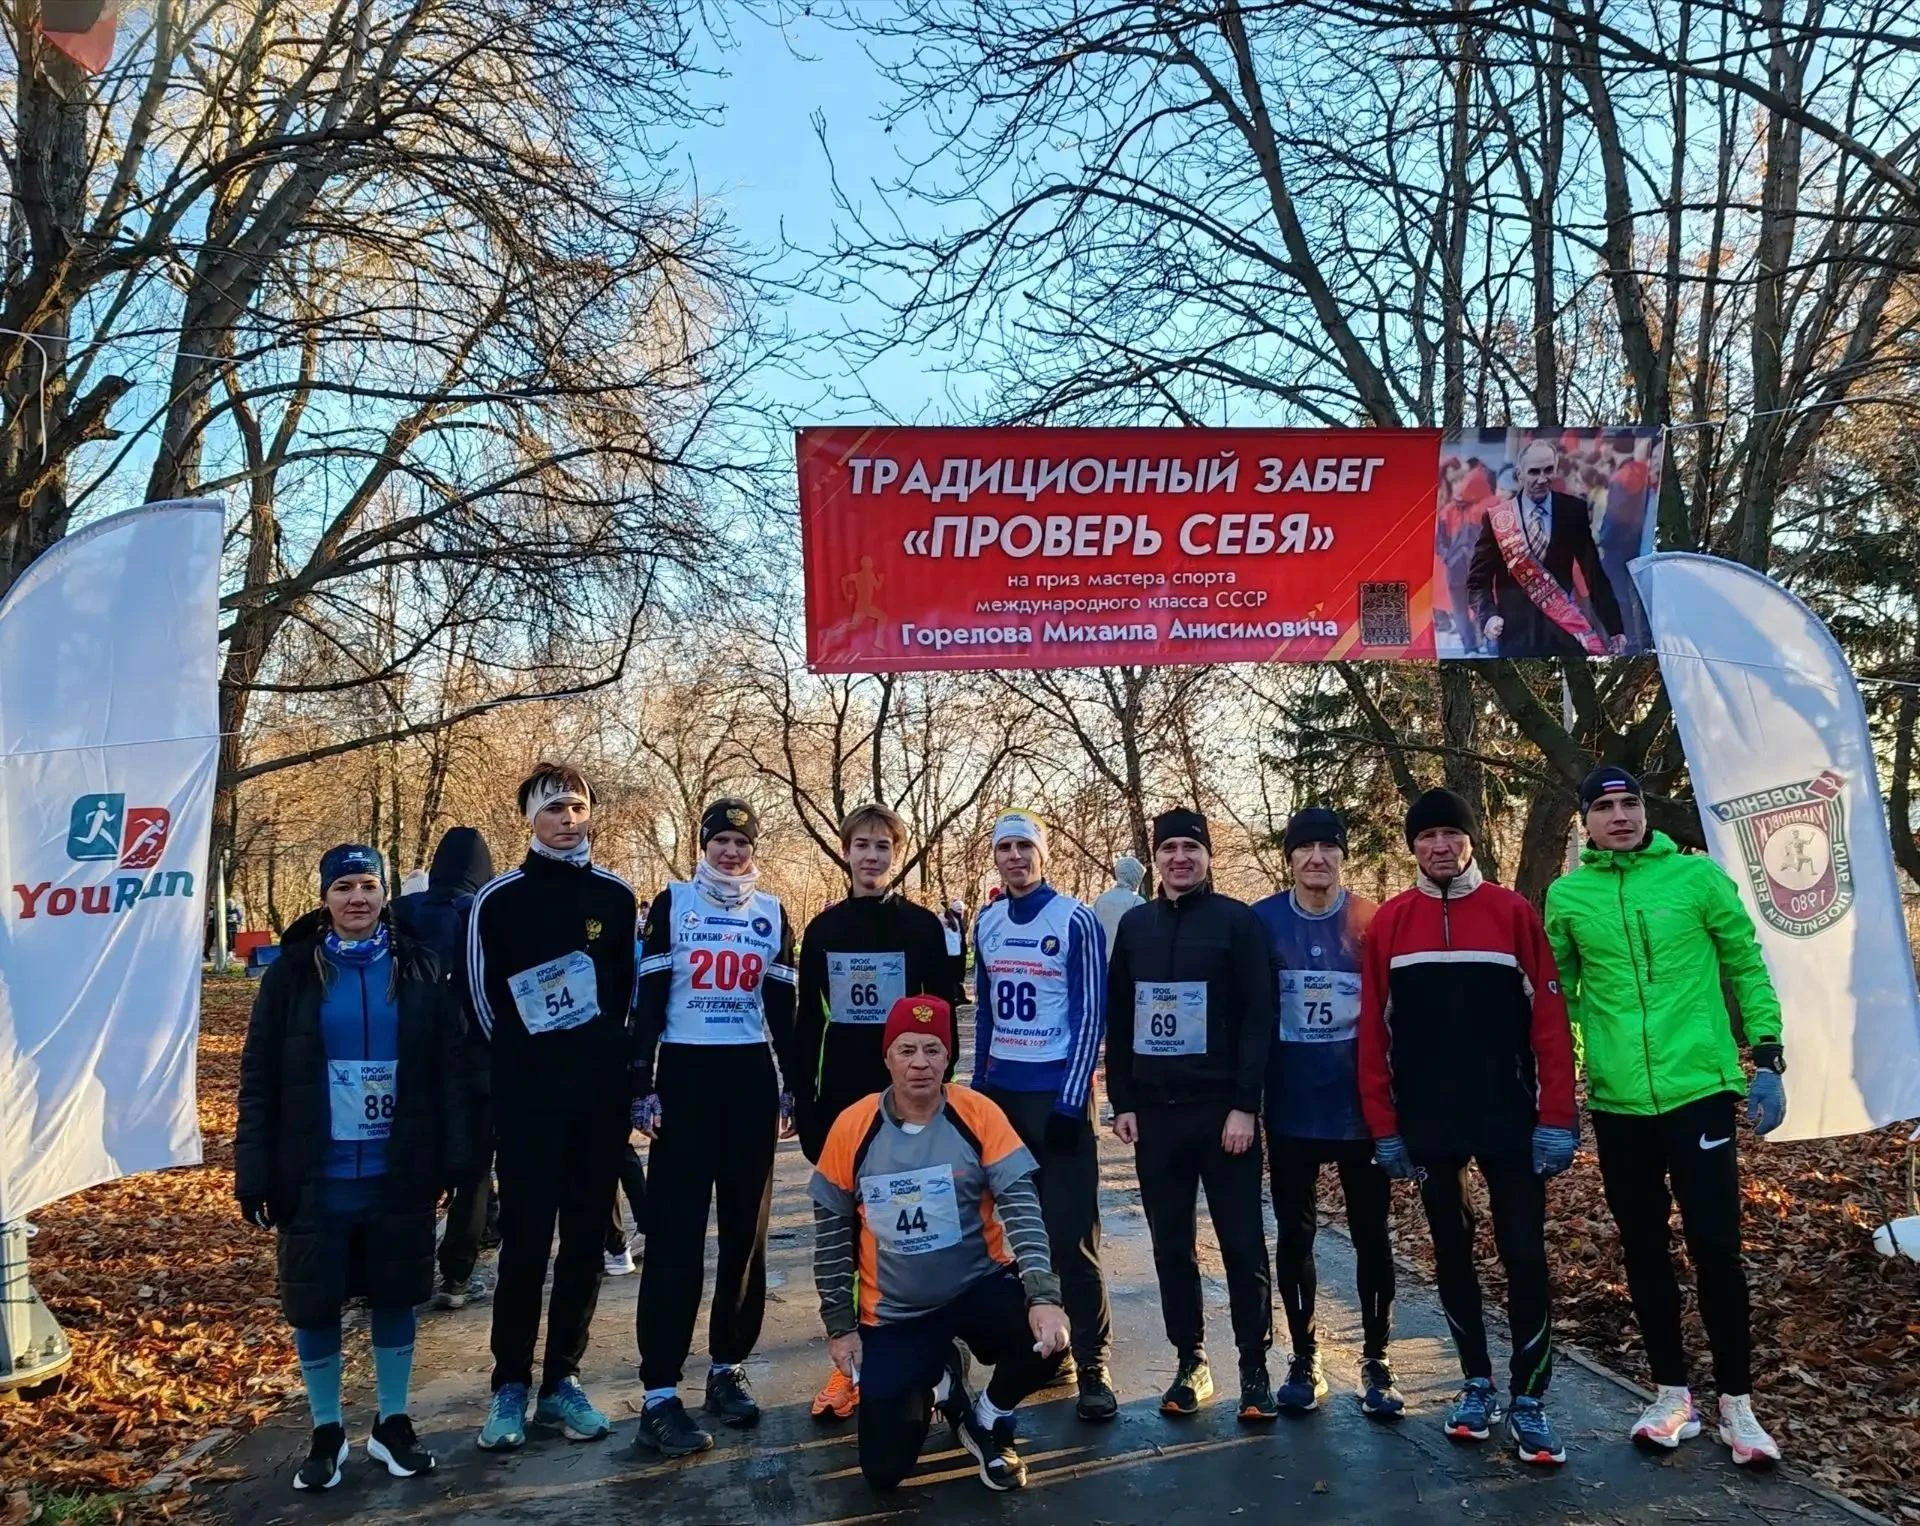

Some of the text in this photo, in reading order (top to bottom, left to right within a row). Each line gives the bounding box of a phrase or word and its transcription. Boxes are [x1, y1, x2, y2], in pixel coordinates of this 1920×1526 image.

[848, 451, 1386, 502] ТРАДИЦИОННЫЙ ЗАБЕГ
[902, 512, 1335, 558] «ПРОВЕРЬ СЕБЯ»
[1007, 570, 1237, 592] на приз мастера спорта
[976, 591, 1269, 615] международного класса СССР
[901, 618, 1339, 649] Горелова Михаила Анисимовича
[689, 949, 763, 993] 208
[545, 986, 574, 1017] 54
[850, 983, 878, 1006] 66
[997, 980, 1037, 1023] 86
[1151, 1013, 1177, 1038] 69
[1304, 1001, 1333, 1025] 75
[364, 1094, 394, 1120] 88
[896, 1206, 928, 1235] 44
